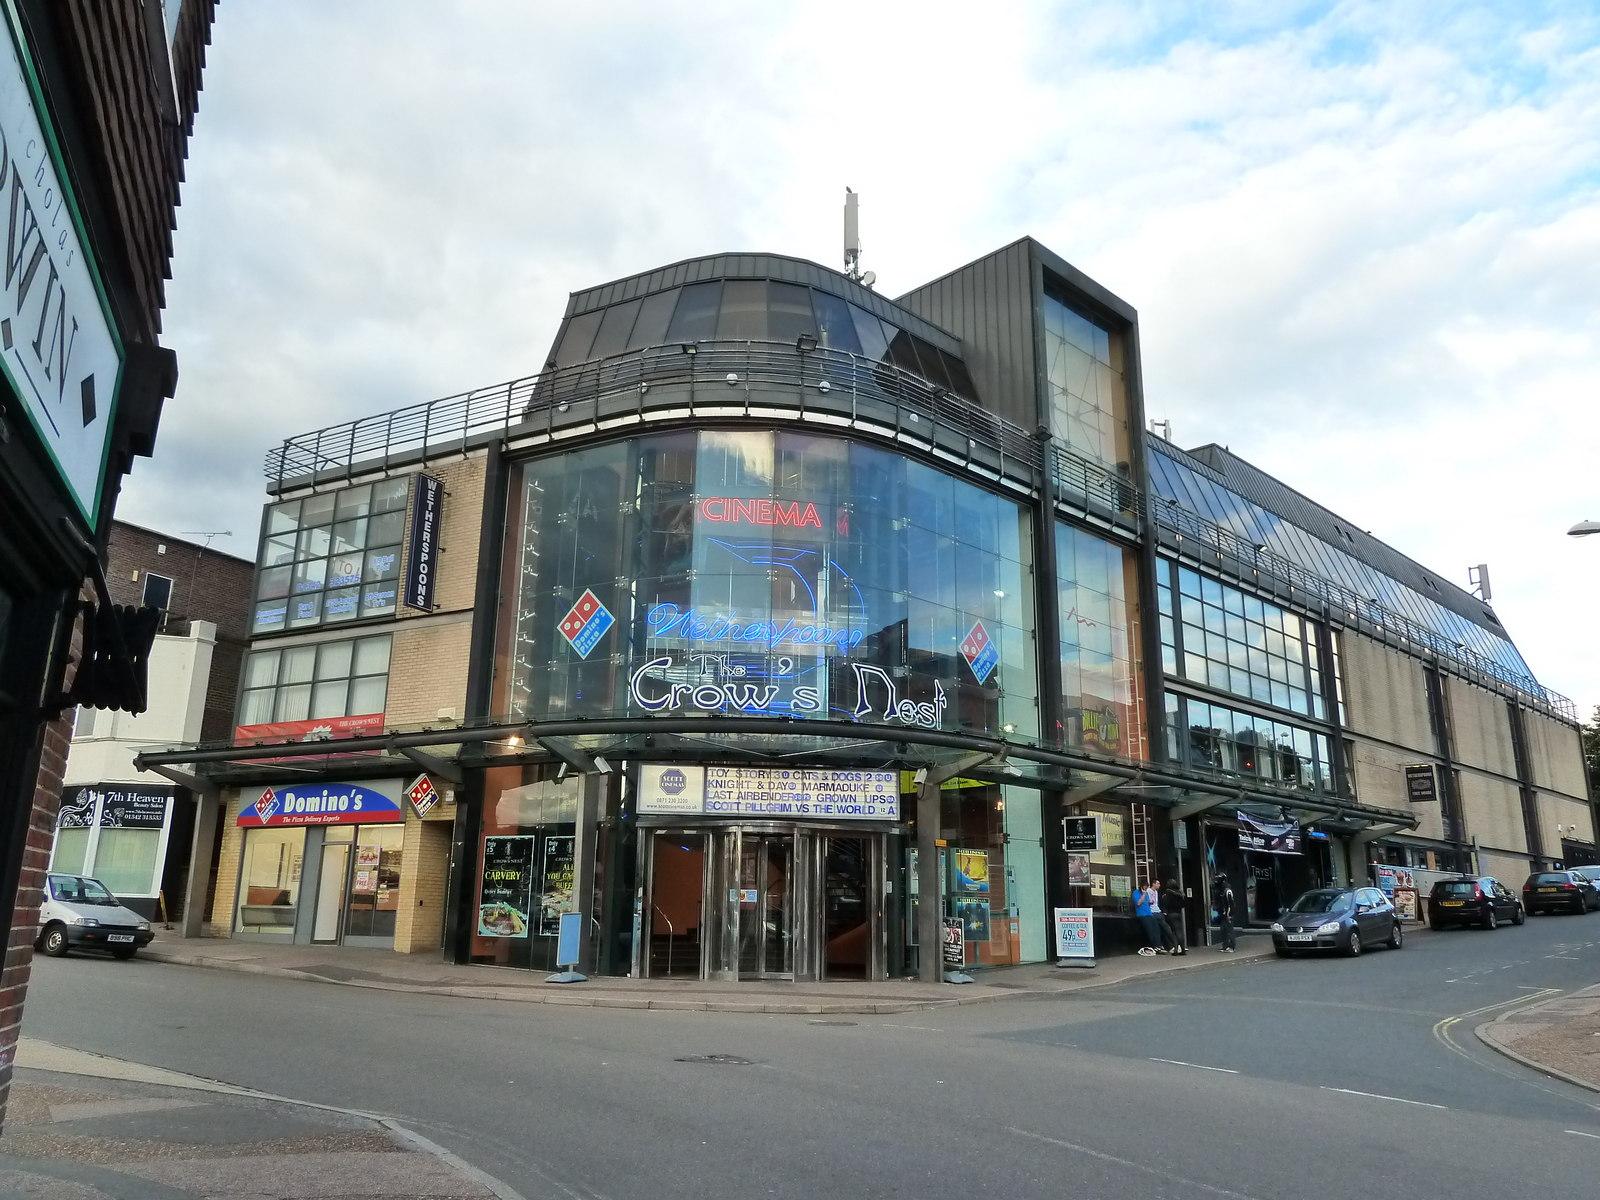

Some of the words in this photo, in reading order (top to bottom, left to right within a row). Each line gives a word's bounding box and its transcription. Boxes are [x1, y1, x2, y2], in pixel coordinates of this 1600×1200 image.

[0, 120, 78, 404] WIN
[702, 496, 822, 528] CINEMA
[416, 478, 438, 607] WETHERSPOONS
[575, 610, 606, 649] Domino's
[580, 630, 600, 654] Pizza
[691, 653, 747, 678] The
[973, 643, 994, 672] Domino's
[631, 656, 821, 711] Crow's
[708, 768, 730, 778] TOY
[735, 769, 771, 779] STORY
[793, 770, 819, 780] CATS
[821, 771, 829, 780] &
[831, 772, 862, 781] DOGS
[865, 773, 872, 781] 2
[707, 779, 751, 790] KNIGHT
[757, 781, 765, 790] &
[768, 781, 788, 791] DAY
[802, 782, 870, 793] MARMADUKE
[107, 791, 124, 804] 7th
[127, 792, 164, 803] Heaven
[283, 789, 363, 813] Domino's
[707, 790, 734, 800] LAST
[737, 791, 794, 801] AIRBENDER
[816, 793, 857, 803] GROWN
[865, 794, 886, 804] UPS
[706, 801, 741, 811] SCOTT
[795, 804, 809, 813] VS
[813, 804, 833, 814] THE
[837, 805, 875, 815] WORLD
[888, 806, 896, 815] A
[304, 815, 322, 823] Delivery
[322, 815, 341, 823] Experts
[1104, 815, 1121, 828] Music
[485, 871, 522, 881] CARVERY
[546, 872, 561, 880] YOU
